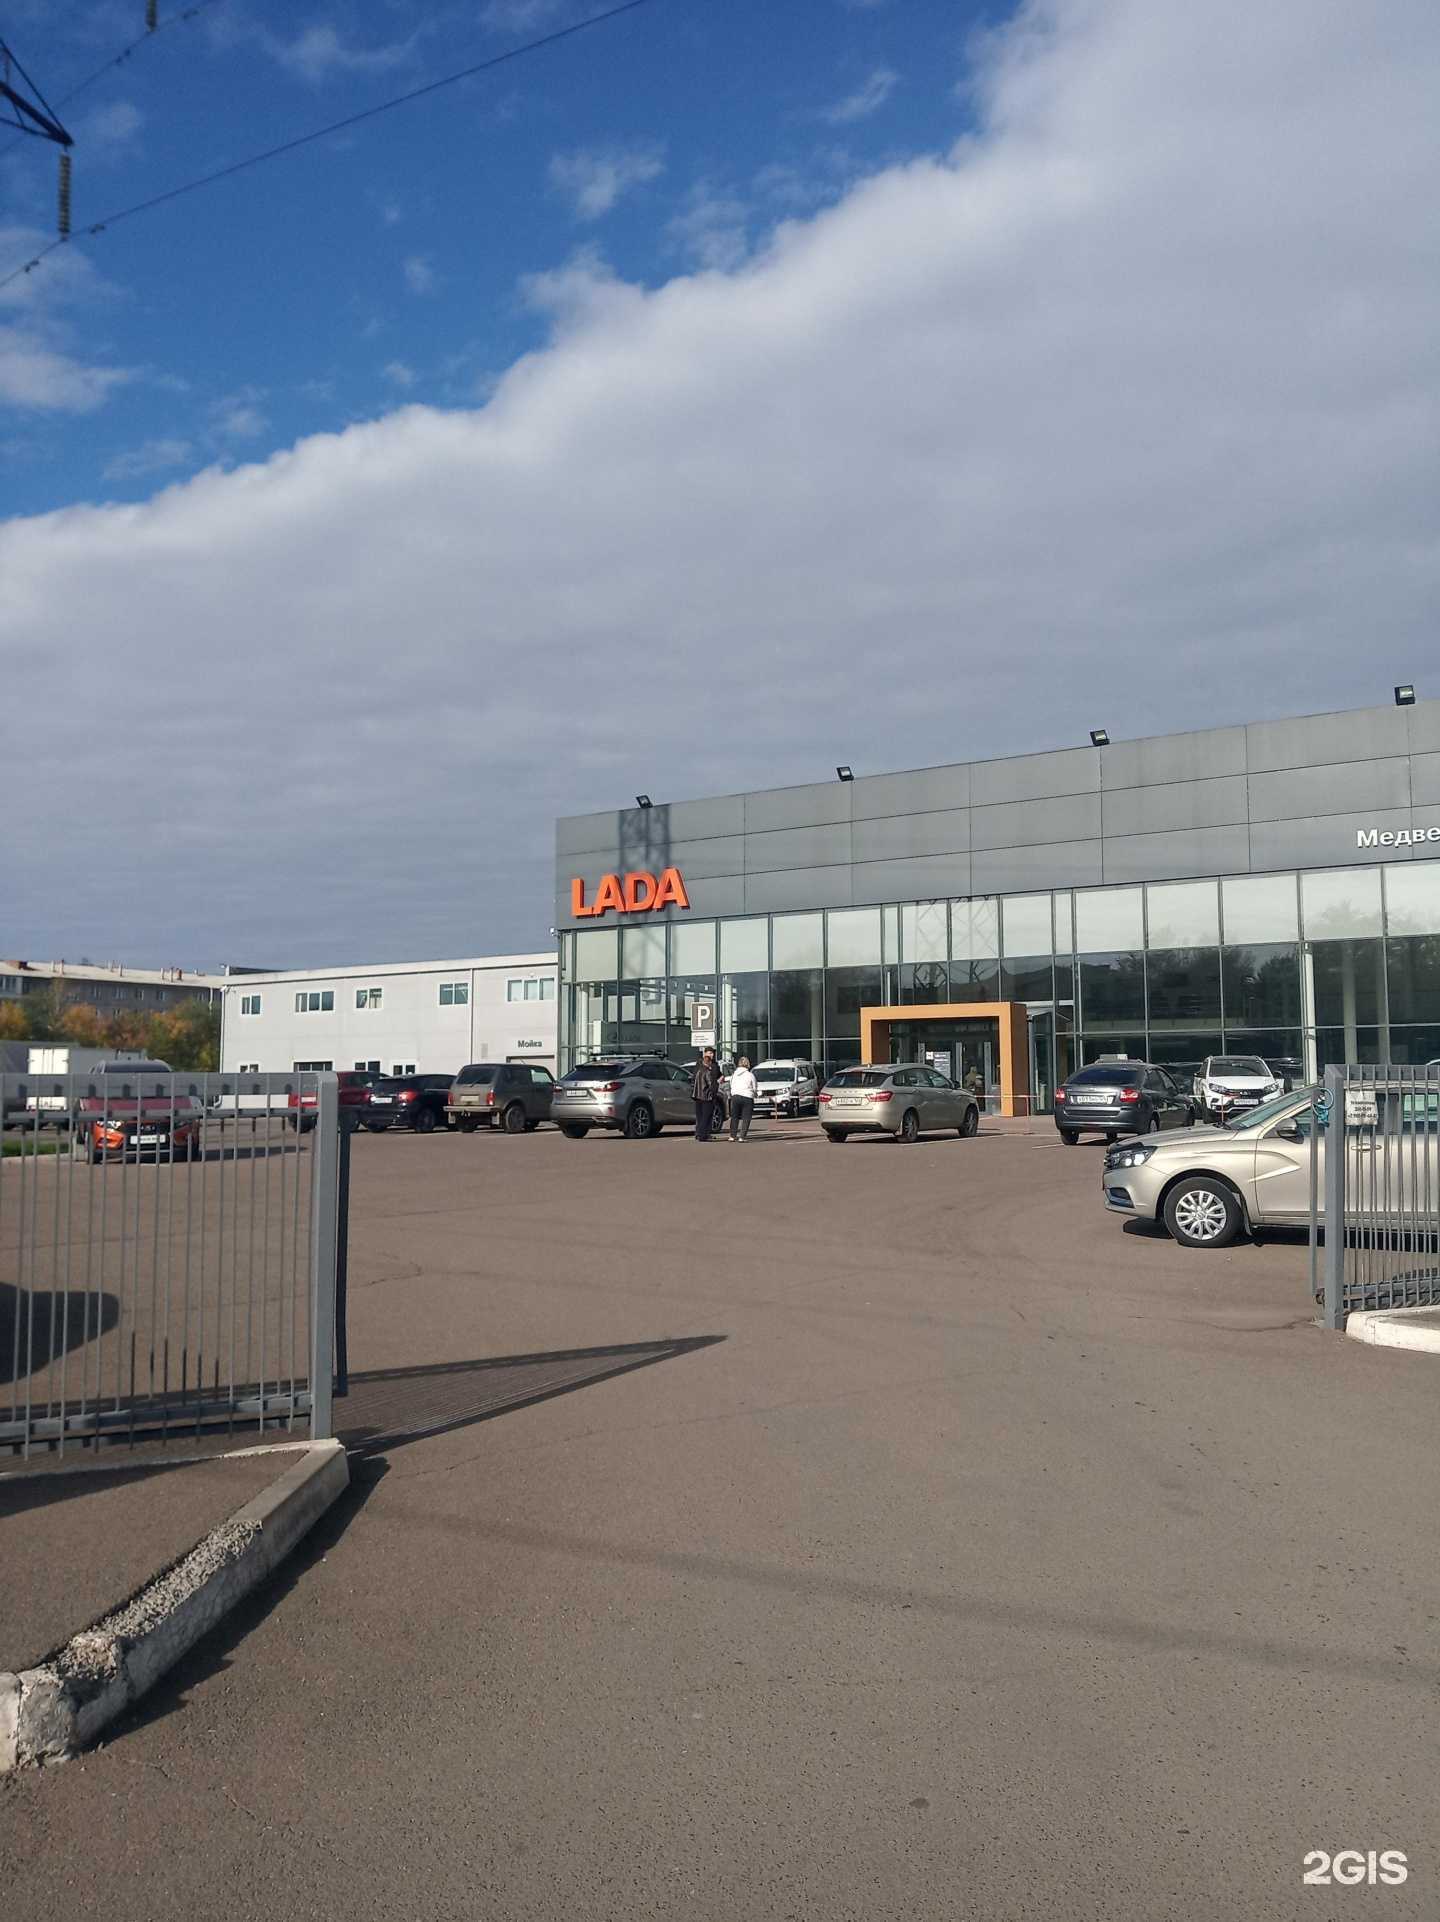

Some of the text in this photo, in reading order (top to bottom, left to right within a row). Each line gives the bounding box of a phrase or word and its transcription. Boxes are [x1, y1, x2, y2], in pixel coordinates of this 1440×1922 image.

[1357, 827, 1440, 847] Медве
[571, 866, 690, 918] LADA
[697, 1005, 710, 1028] P
[518, 1039, 542, 1048] Мойка
